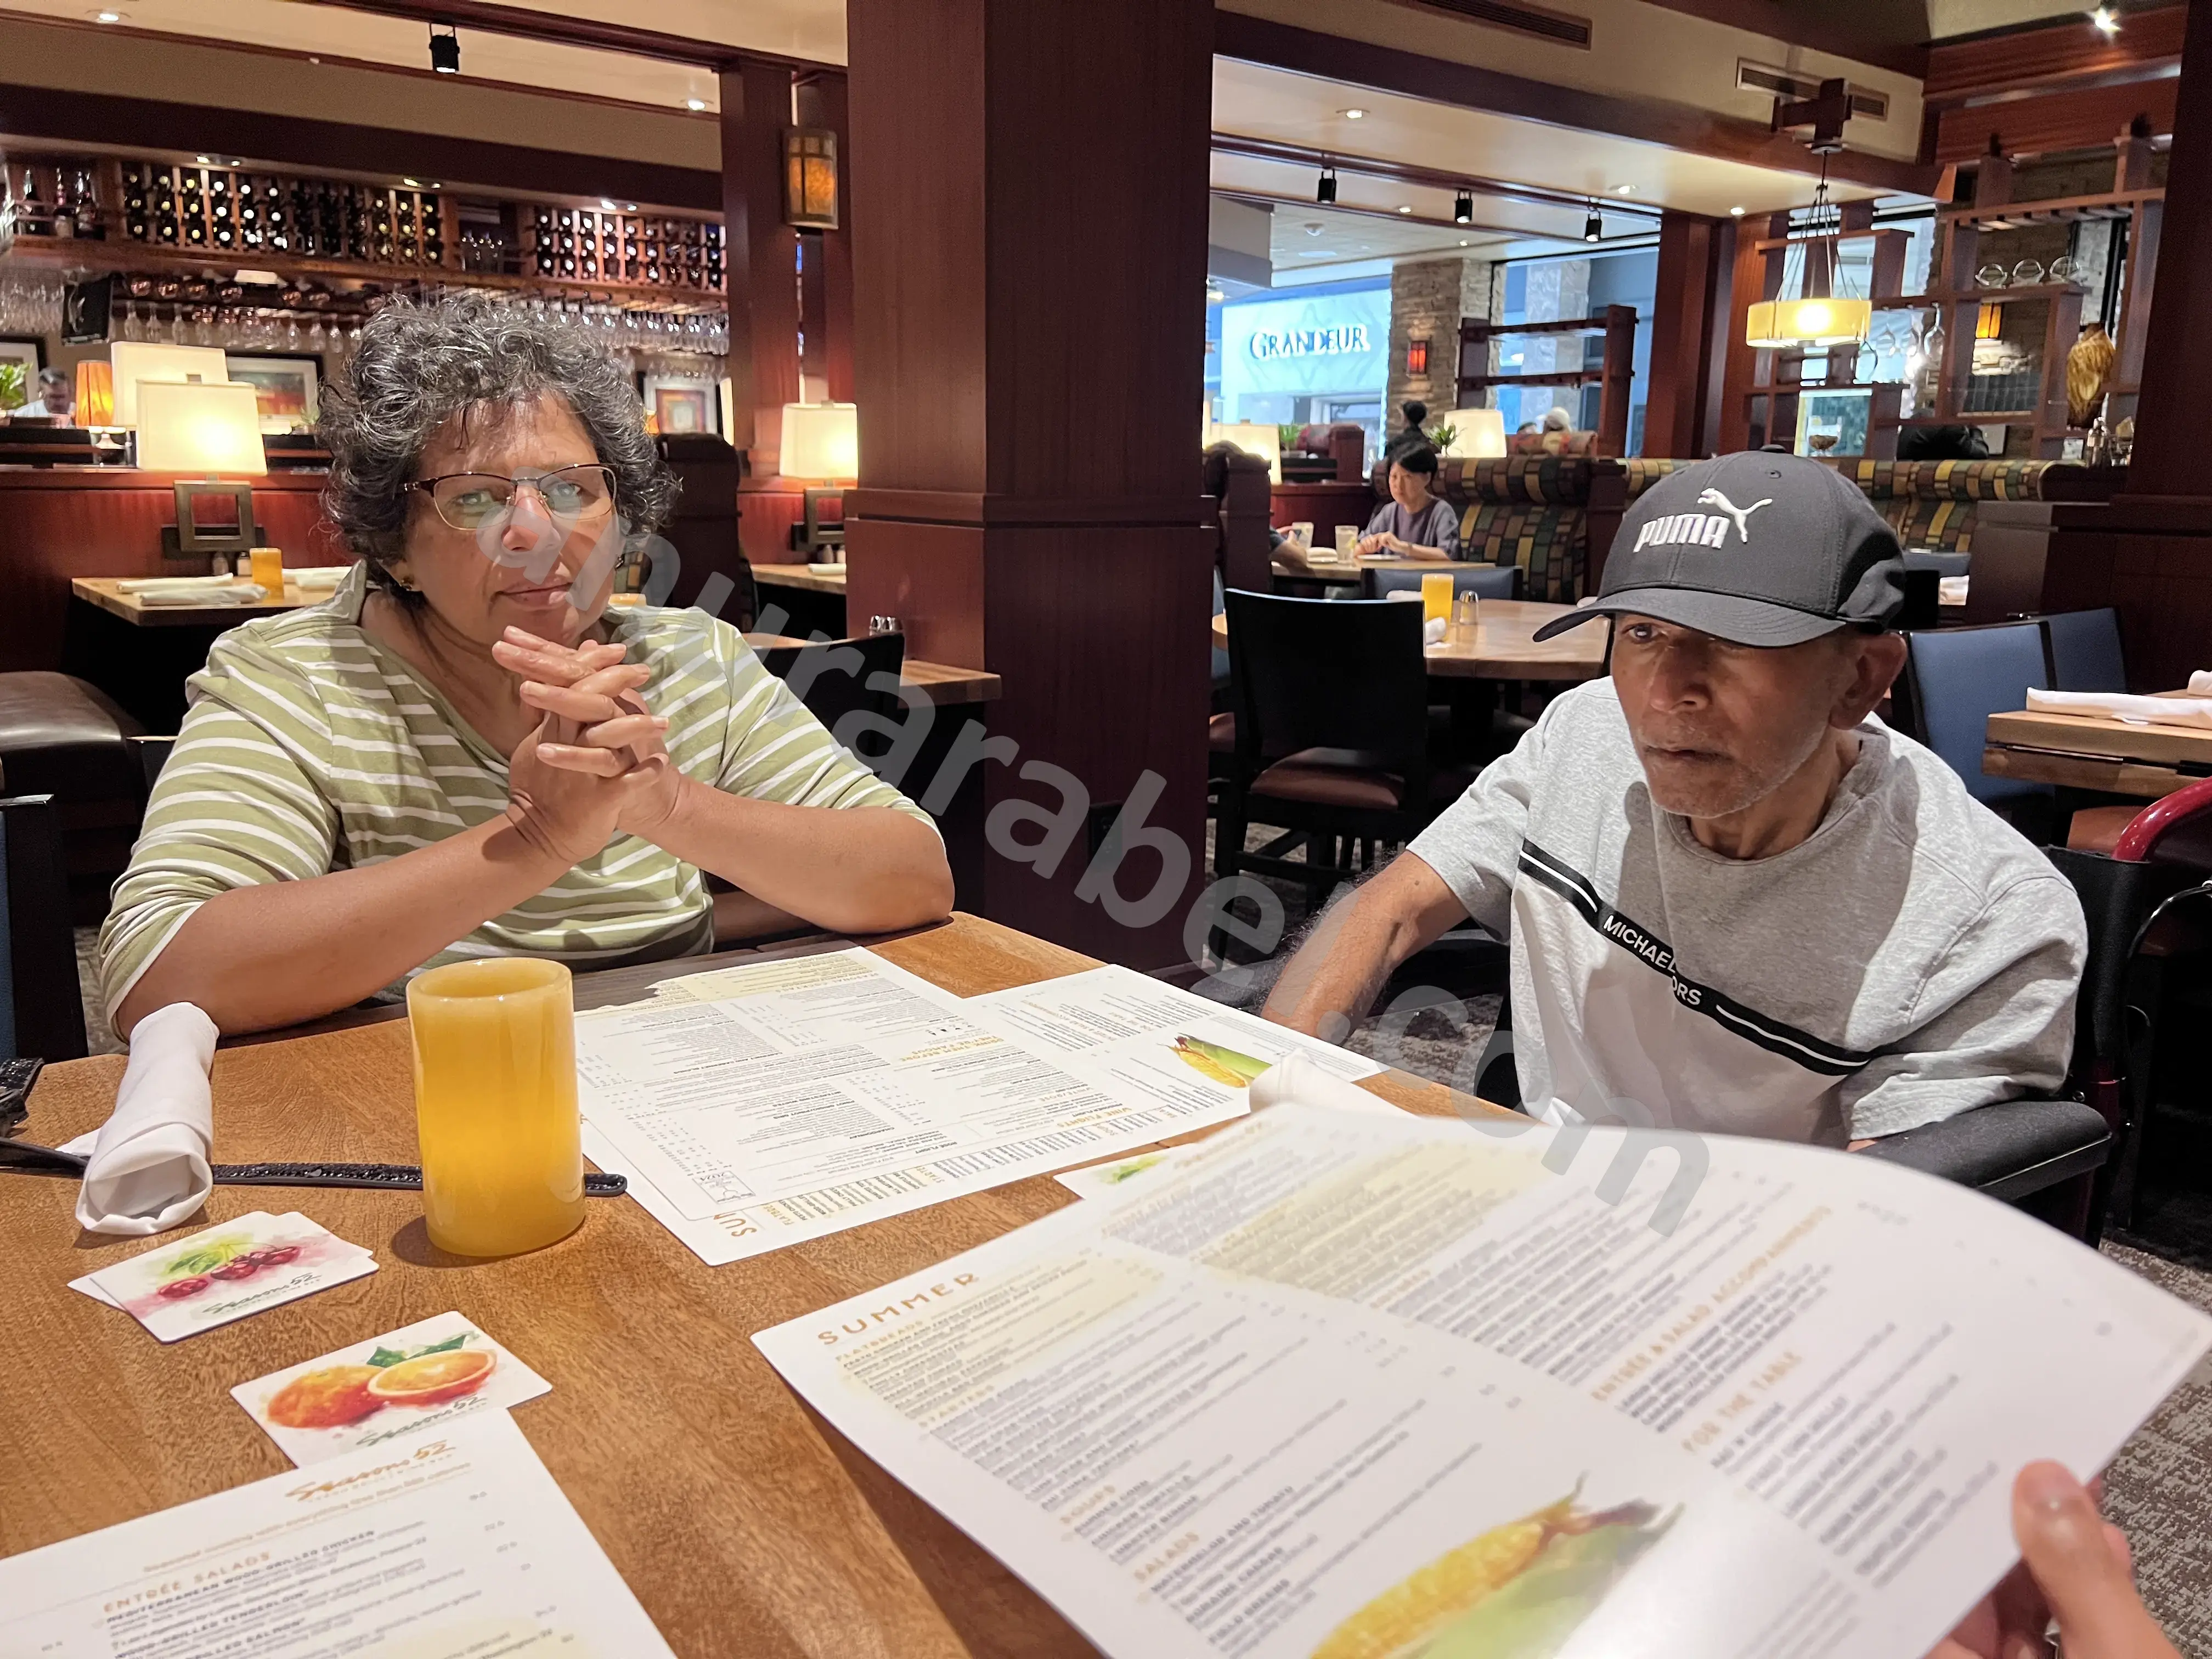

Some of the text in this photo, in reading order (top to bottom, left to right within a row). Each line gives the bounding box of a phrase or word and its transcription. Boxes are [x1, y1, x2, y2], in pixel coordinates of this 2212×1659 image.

[1250, 323, 1370, 361] GRANDEUR
[1633, 514, 1730, 553] PUMA
[1603, 915, 1676, 973] MICHAEL
[290, 1272, 323, 1284] 52
[818, 1273, 979, 1345] SUMMER
[453, 1393, 488, 1409] 52
[414, 1439, 456, 1460] 52
